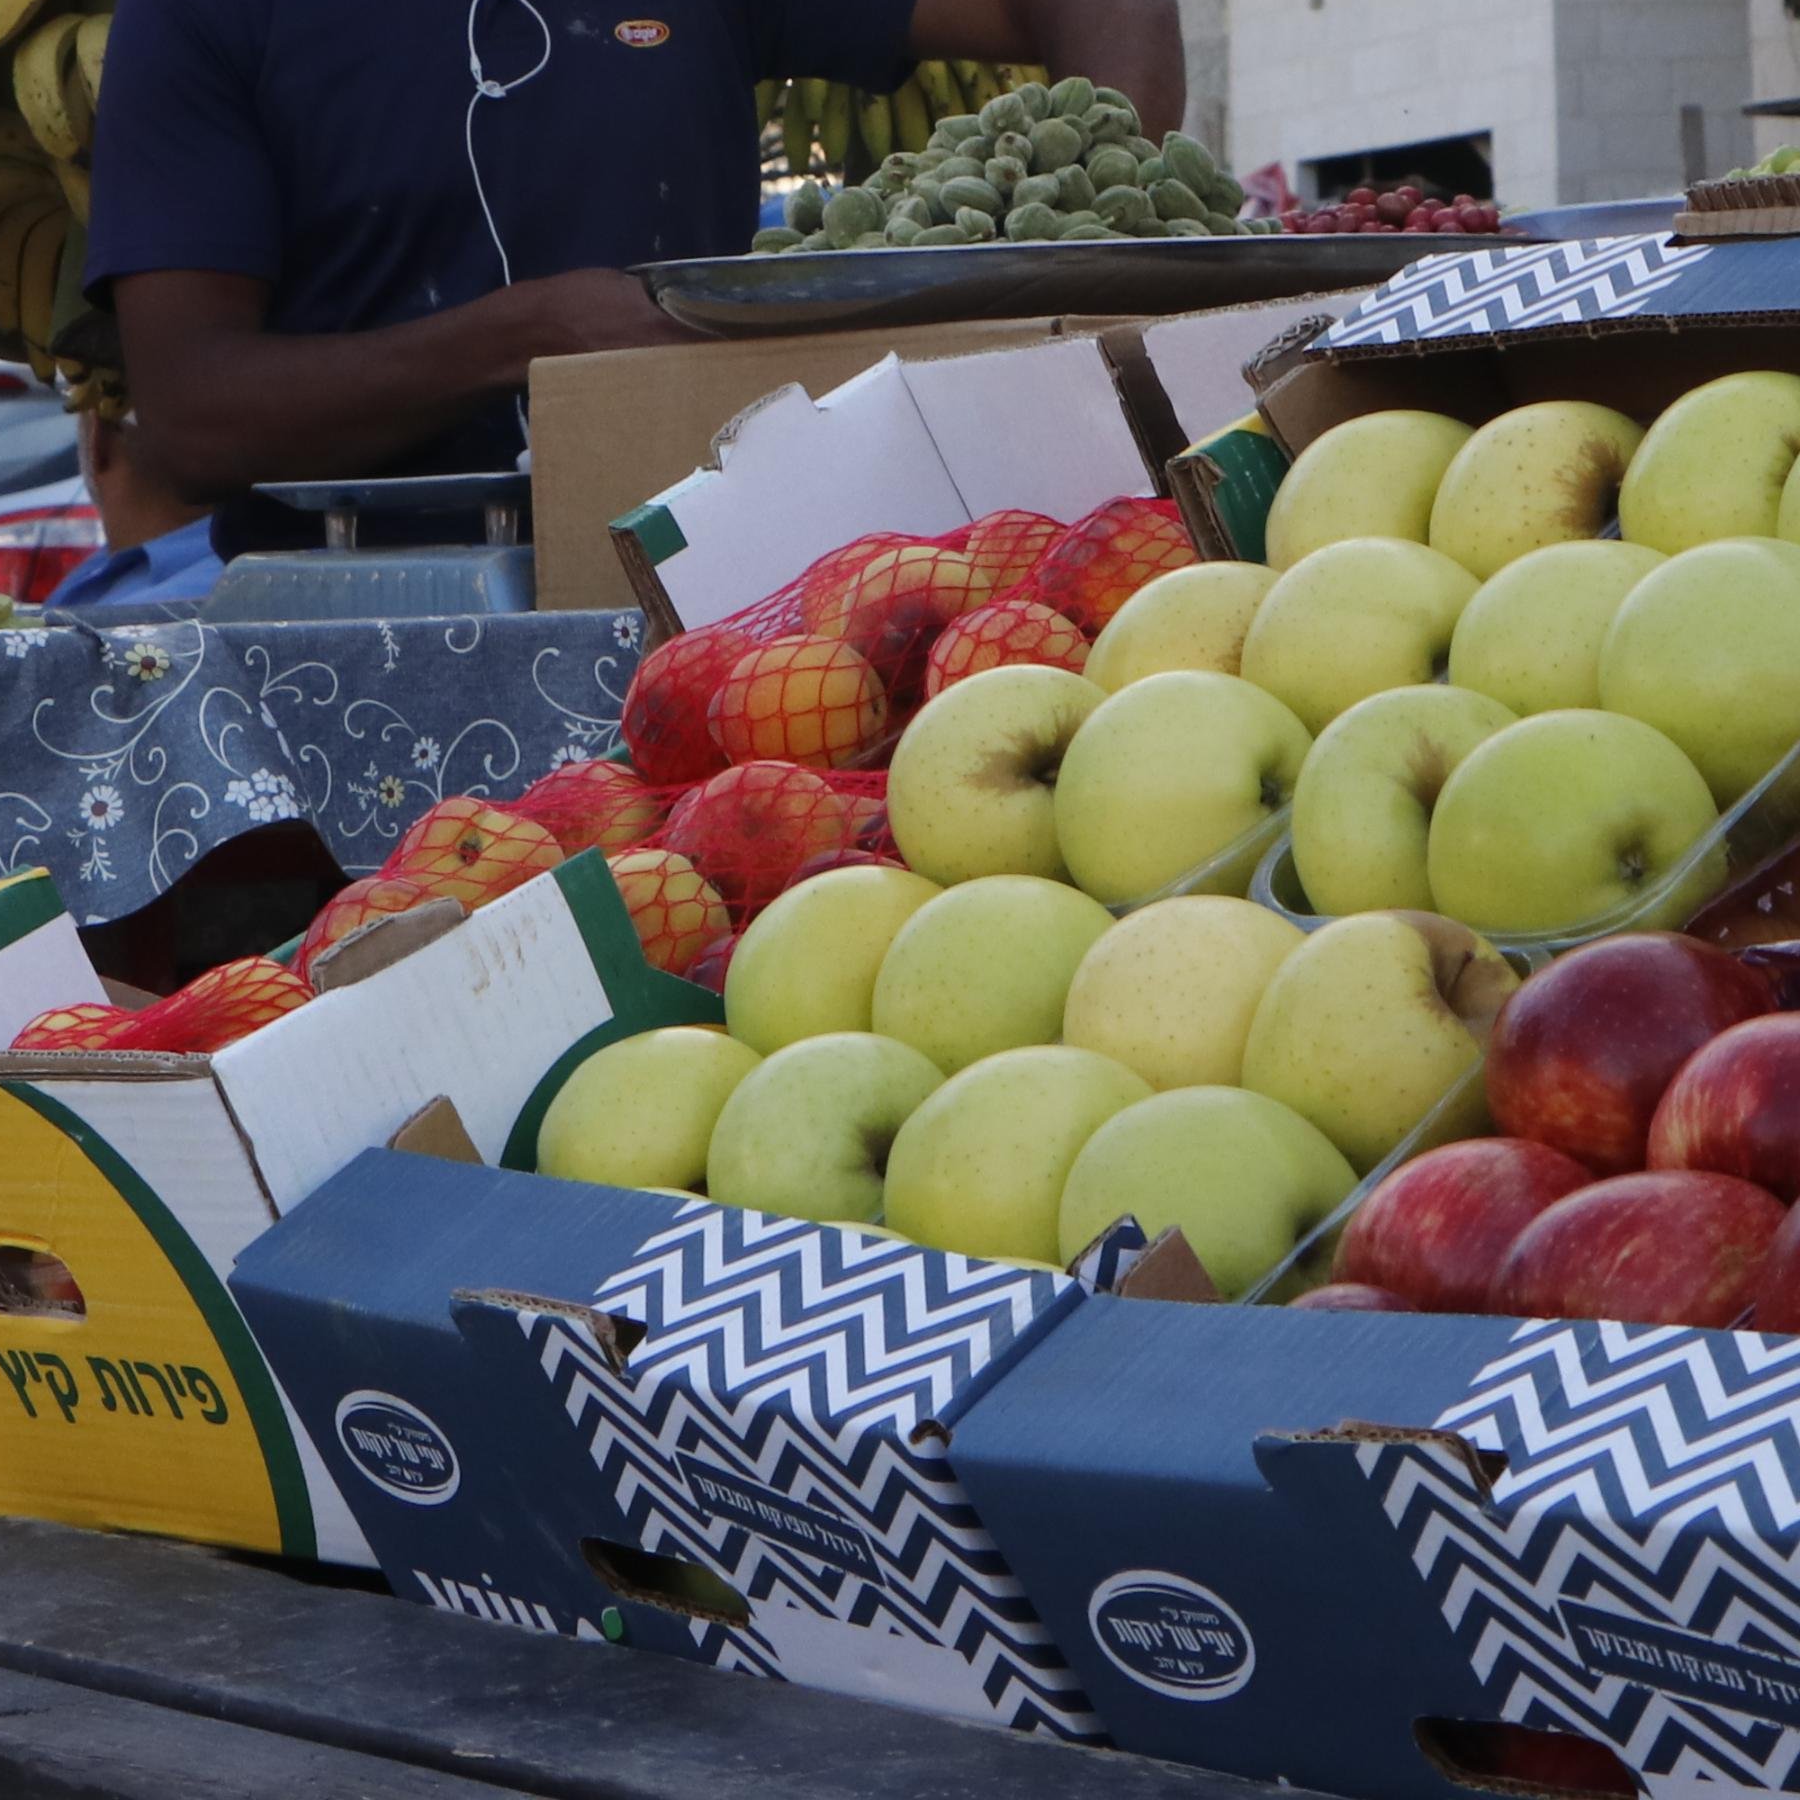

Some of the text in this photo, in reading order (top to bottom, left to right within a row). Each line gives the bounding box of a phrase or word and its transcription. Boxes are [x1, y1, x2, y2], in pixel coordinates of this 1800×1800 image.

[85, 1355, 229, 1425] פירות
[350, 1426, 446, 1471] יופי של ירקות
[691, 1472, 867, 1563] גידול מפוקח ומבוקר
[1107, 1616, 1236, 1659] יופי של ירקות
[1577, 1623, 1666, 1669] ומבוקר
[1665, 1648, 1747, 1691] מפוקח
